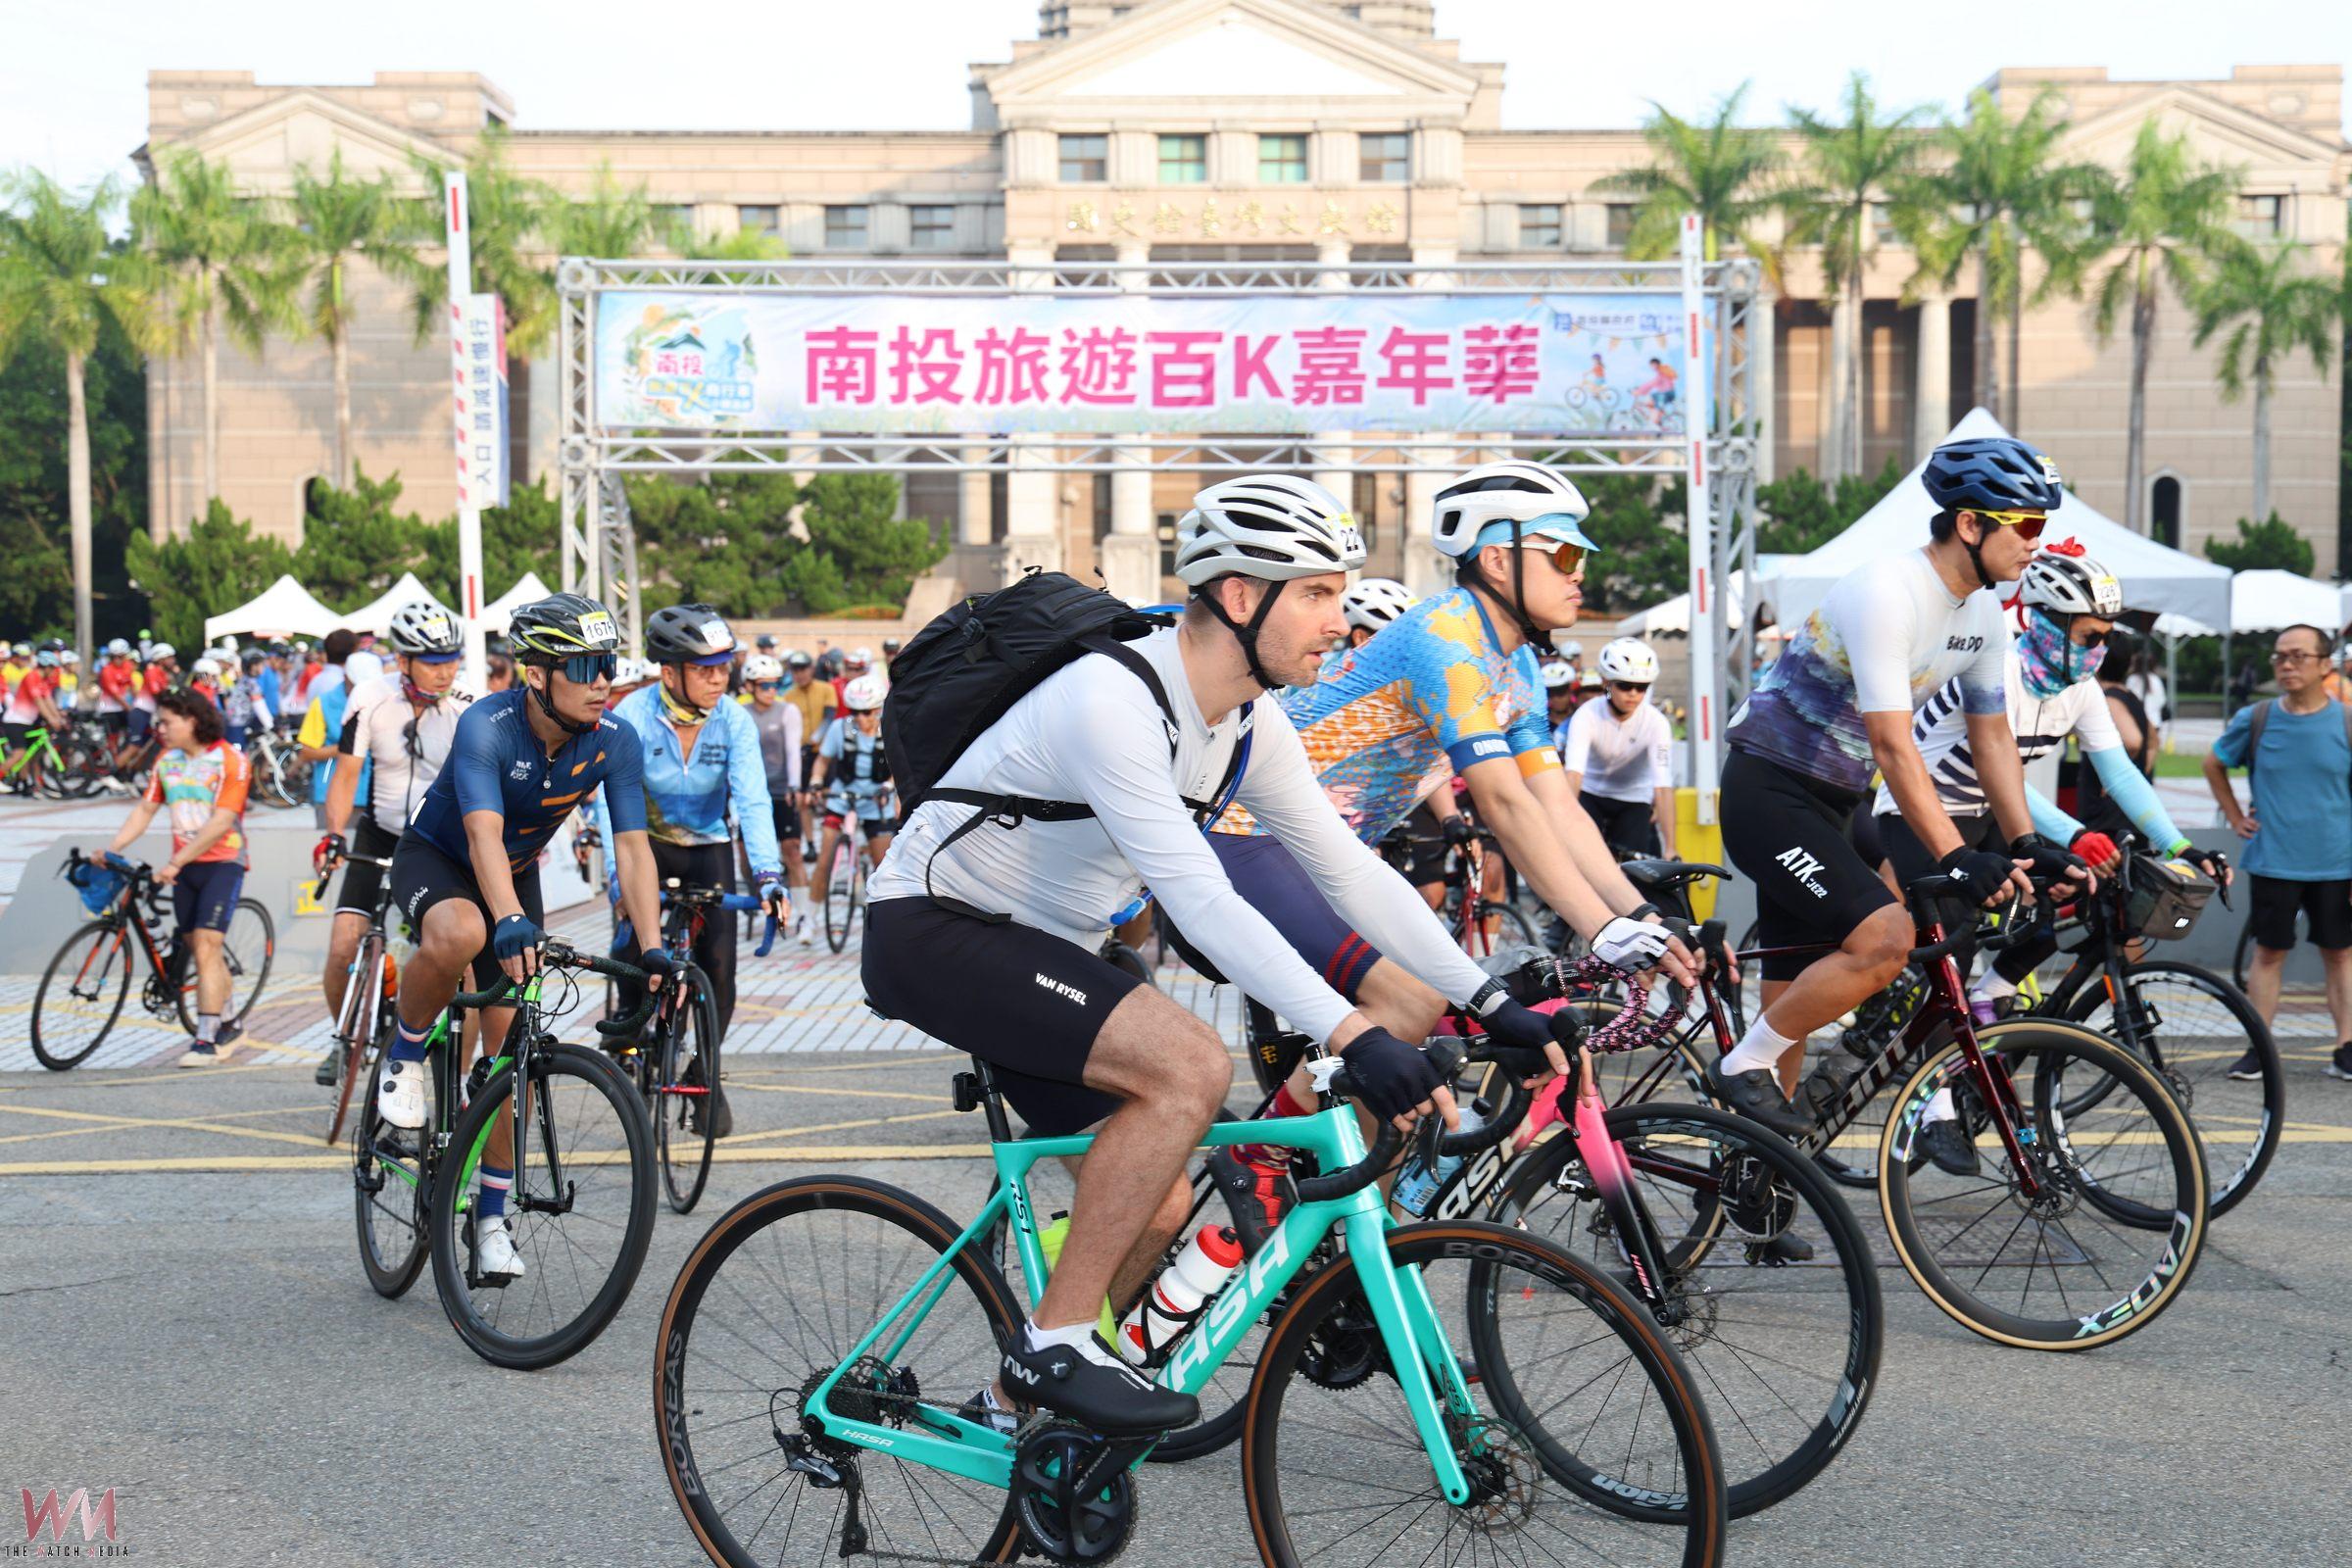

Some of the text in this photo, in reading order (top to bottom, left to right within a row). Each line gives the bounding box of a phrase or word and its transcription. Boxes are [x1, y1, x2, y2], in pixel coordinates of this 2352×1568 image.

[658, 353, 704, 375] 南投
[804, 324, 1540, 408] 南投旅遊百K嘉年華
[1775, 846, 1826, 884] ATK
[1036, 972, 1087, 1005] VAN RYSEL
[1443, 1241, 1616, 1321] BOREAS
[2072, 1209, 2192, 1339] CADEX
[663, 1329, 702, 1496] BOREAS
[842, 1429, 896, 1448] HASA
